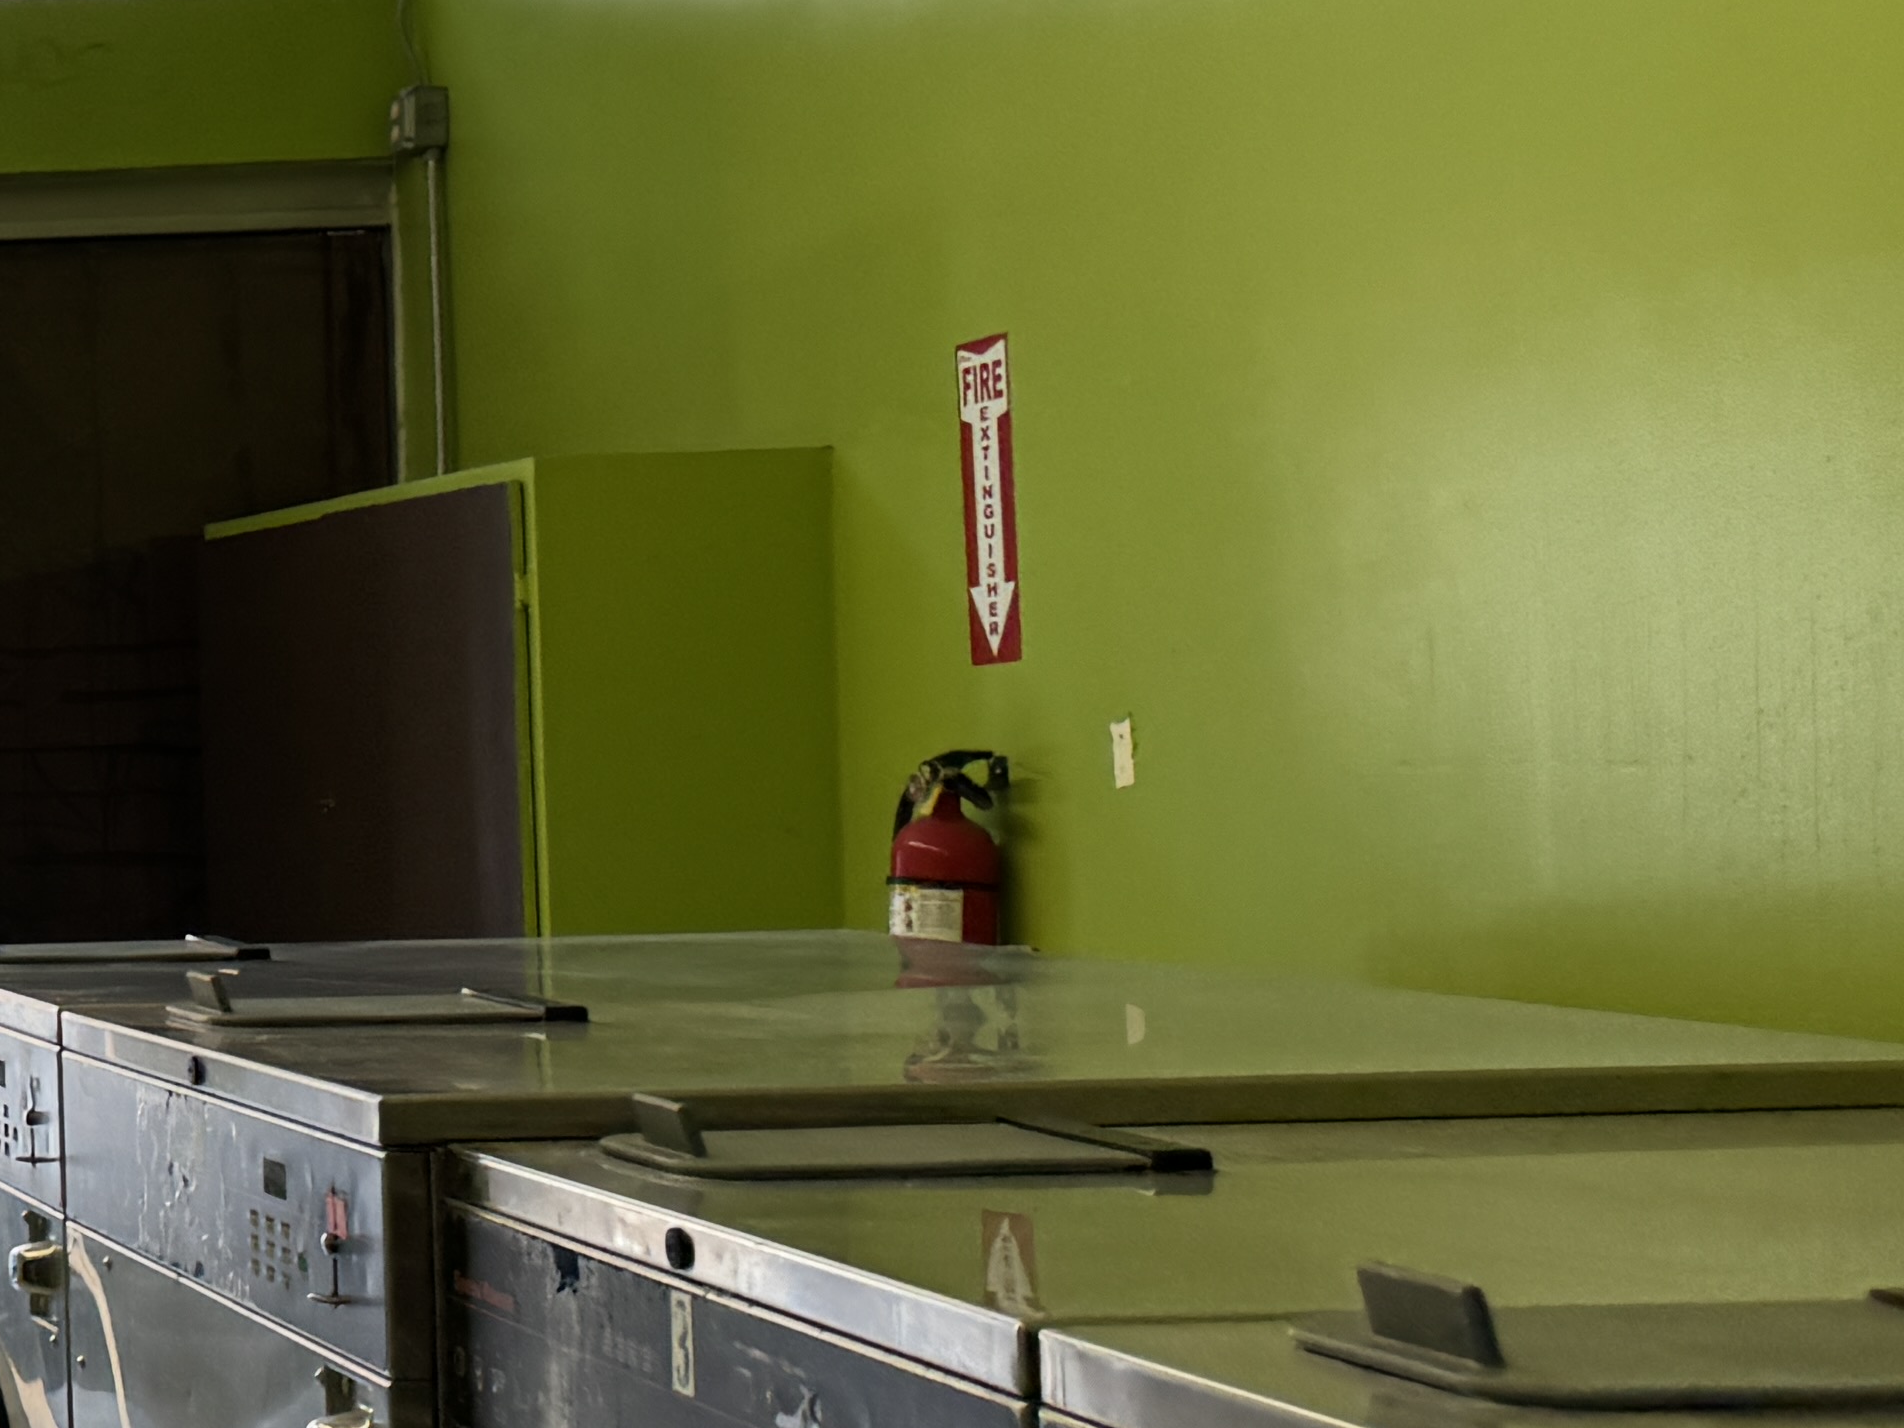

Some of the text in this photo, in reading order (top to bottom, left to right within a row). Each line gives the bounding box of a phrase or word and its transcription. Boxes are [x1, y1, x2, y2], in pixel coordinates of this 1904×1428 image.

[962, 359, 1004, 407] FIRE
[979, 405, 1001, 638] EXTINGUISHER
[674, 1298, 691, 1390] 3
